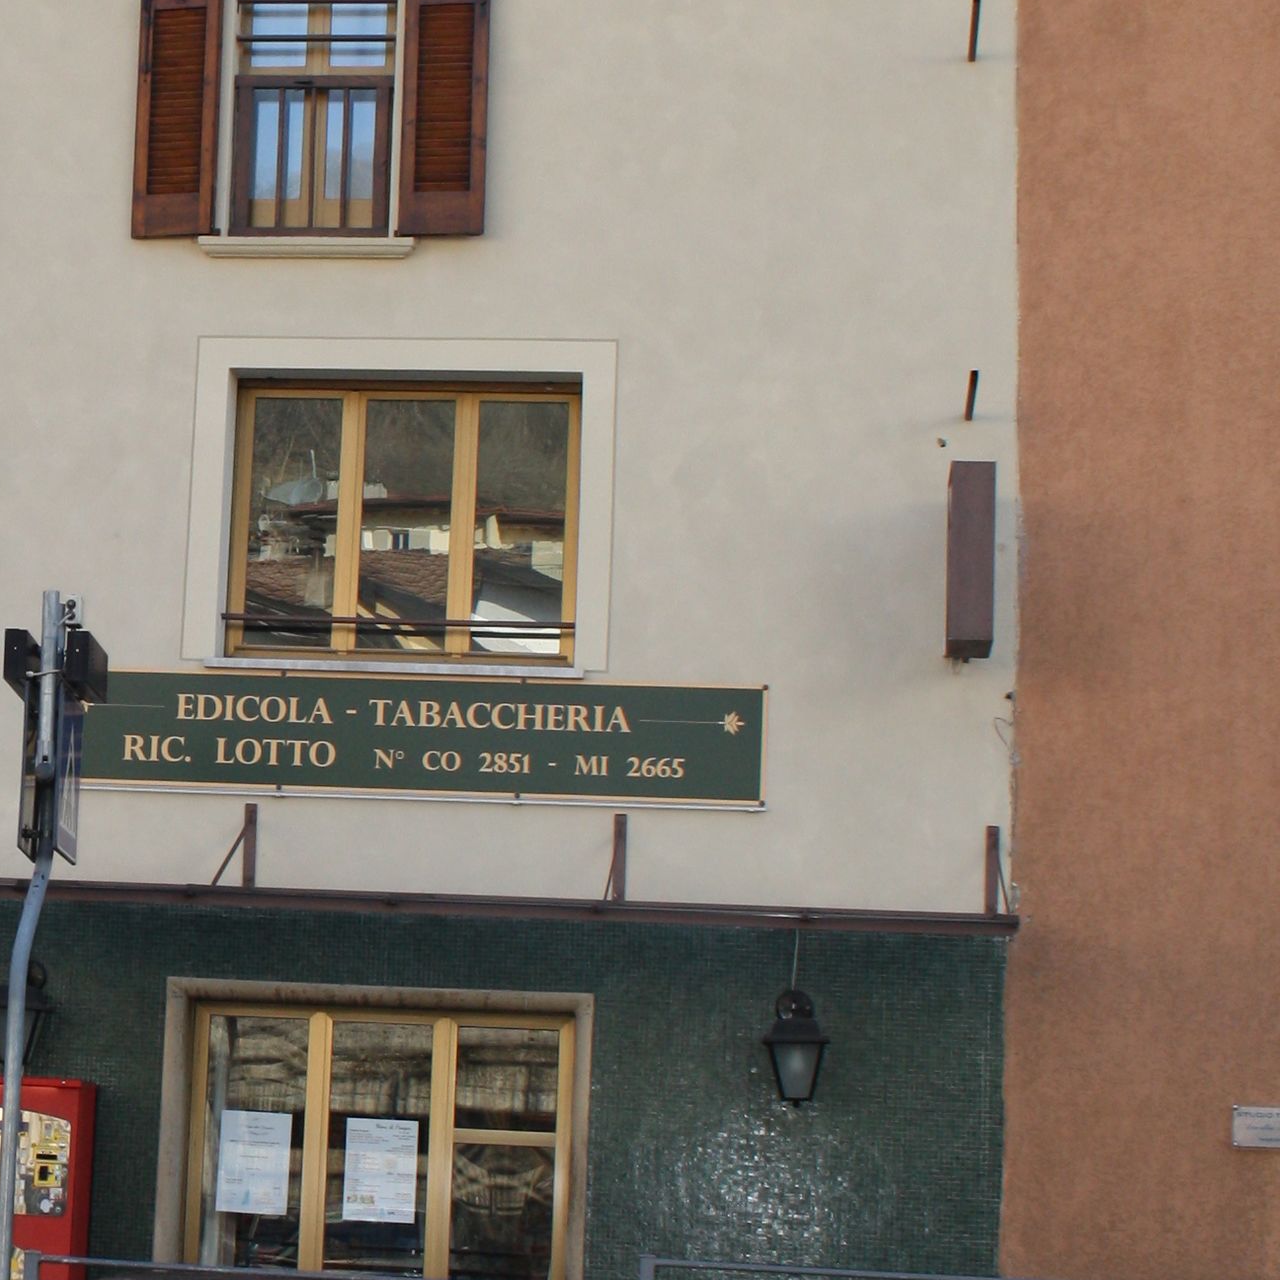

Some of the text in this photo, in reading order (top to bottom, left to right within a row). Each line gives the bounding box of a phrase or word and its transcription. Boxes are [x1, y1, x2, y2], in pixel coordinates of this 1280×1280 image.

[175, 693, 333, 726] EDICOLA
[369, 699, 632, 735] TABACCHERIA
[122, 734, 192, 764] RIC.
[215, 737, 337, 769] LOTTO
[422, 750, 462, 773] CO
[478, 752, 532, 775] 2851
[574, 755, 609, 777] MI
[626, 756, 686, 780] 2665
